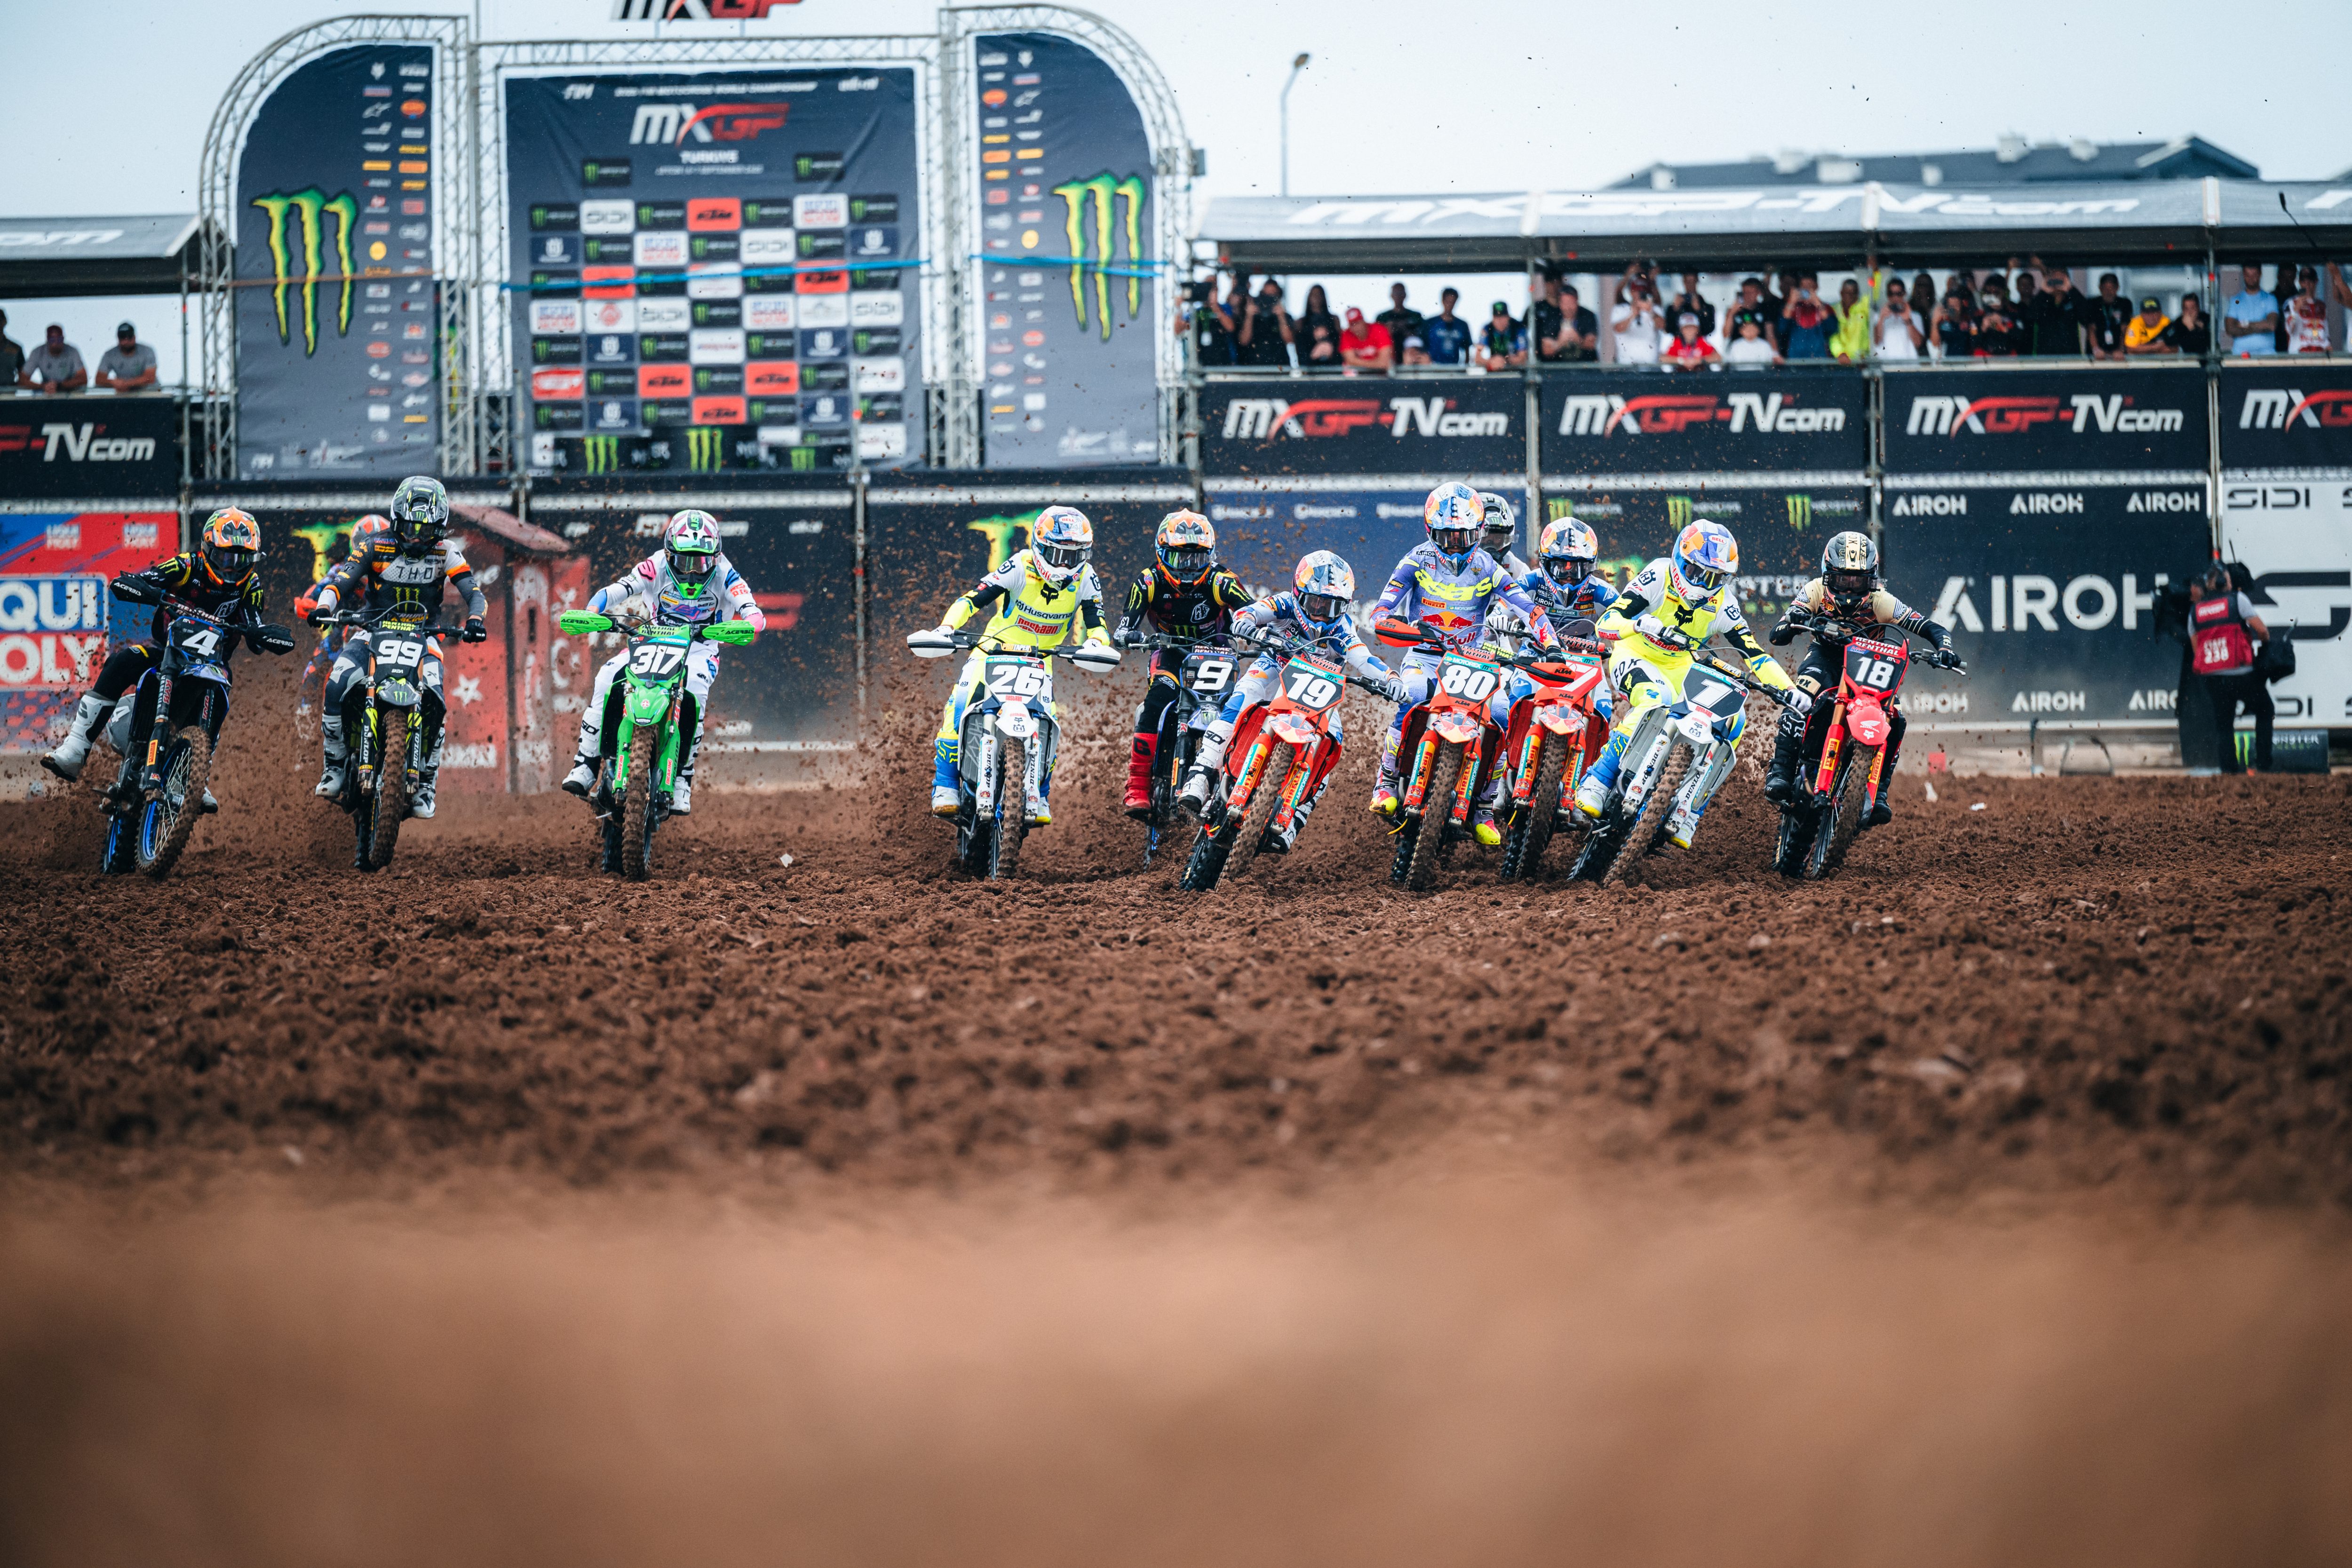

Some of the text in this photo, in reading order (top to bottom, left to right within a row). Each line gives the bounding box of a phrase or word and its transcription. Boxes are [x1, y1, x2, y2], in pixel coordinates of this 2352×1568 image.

[1892, 494, 1967, 516] AIROH
[2009, 492, 2084, 514] AIROH
[2126, 491, 2201, 512] AIROH
[114, 582, 142, 597] ACERBIS
[1673, 573, 1688, 597] Bull
[1422, 598, 1446, 609] PIRELLI
[1535, 596, 1553, 607] AIROH
[1578, 594, 1593, 603] KTM
[1024, 606, 1073, 620] Husqvarna
[182, 629, 220, 657] 4
[266, 637, 294, 647] ACERBIS
[1447, 632, 1476, 645] Bull
[1855, 642, 1899, 656] RENTHAL
[376, 639, 423, 668] 99
[629, 645, 686, 675] 317
[1452, 657, 1482, 669] MOTOREX
[988, 665, 1045, 696] 26
[1192, 660, 1233, 691] 9
[1298, 662, 1328, 678] MOTOREX
[1481, 665, 1500, 674] MX2
[1549, 662, 1599, 692] 7
[1614, 659, 1642, 686] FOX
[1700, 666, 1724, 680] MOTOREX
[1854, 656, 1895, 689] 18
[1287, 672, 1337, 708] 19
[1441, 664, 1496, 700] 80
[1691, 679, 1734, 709] 1
[2011, 690, 2086, 712] AIROH
[1294, 705, 1310, 714] KTM
[1695, 705, 1713, 718] nestaan
[1859, 725, 1880, 733] HONDA
[1469, 760, 1480, 790] MOTOREX
[1641, 752, 1659, 786] DUNOP
[1872, 754, 1882, 781] PIRELLI
[1296, 772, 1310, 800] MOTOREX
[1685, 772, 1700, 800] DUNLO
